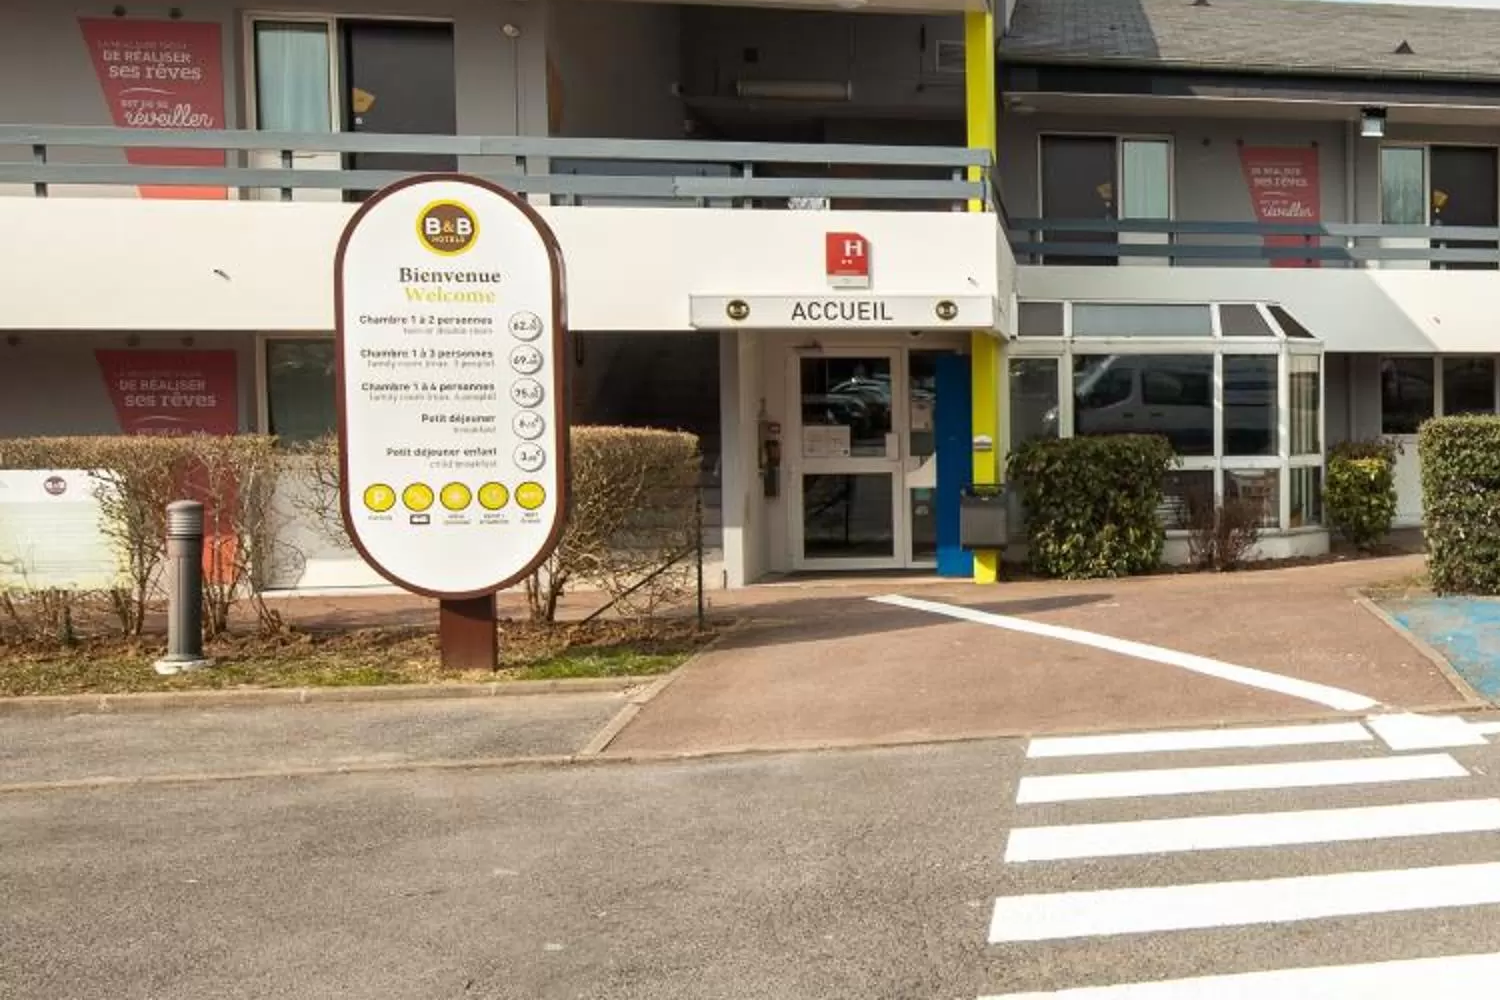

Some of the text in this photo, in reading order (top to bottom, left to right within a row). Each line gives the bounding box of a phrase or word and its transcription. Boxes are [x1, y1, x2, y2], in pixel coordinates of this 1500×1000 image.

[103, 50, 121, 62] DE
[109, 63, 202, 80] ses rêves
[125, 103, 215, 128] réveiller
[425, 217, 473, 235] B&B
[843, 239, 865, 257] H
[399, 267, 501, 283] Bienvenue
[405, 286, 497, 304] Welcome
[791, 301, 893, 321] ACCUEIL
[359, 315, 407, 325] Chambre
[360, 349, 408, 359] Chambre
[438, 350, 493, 359] personnes
[361, 383, 410, 392] Chambre
[440, 383, 495, 393] personnes
[422, 413, 447, 423] Petit
